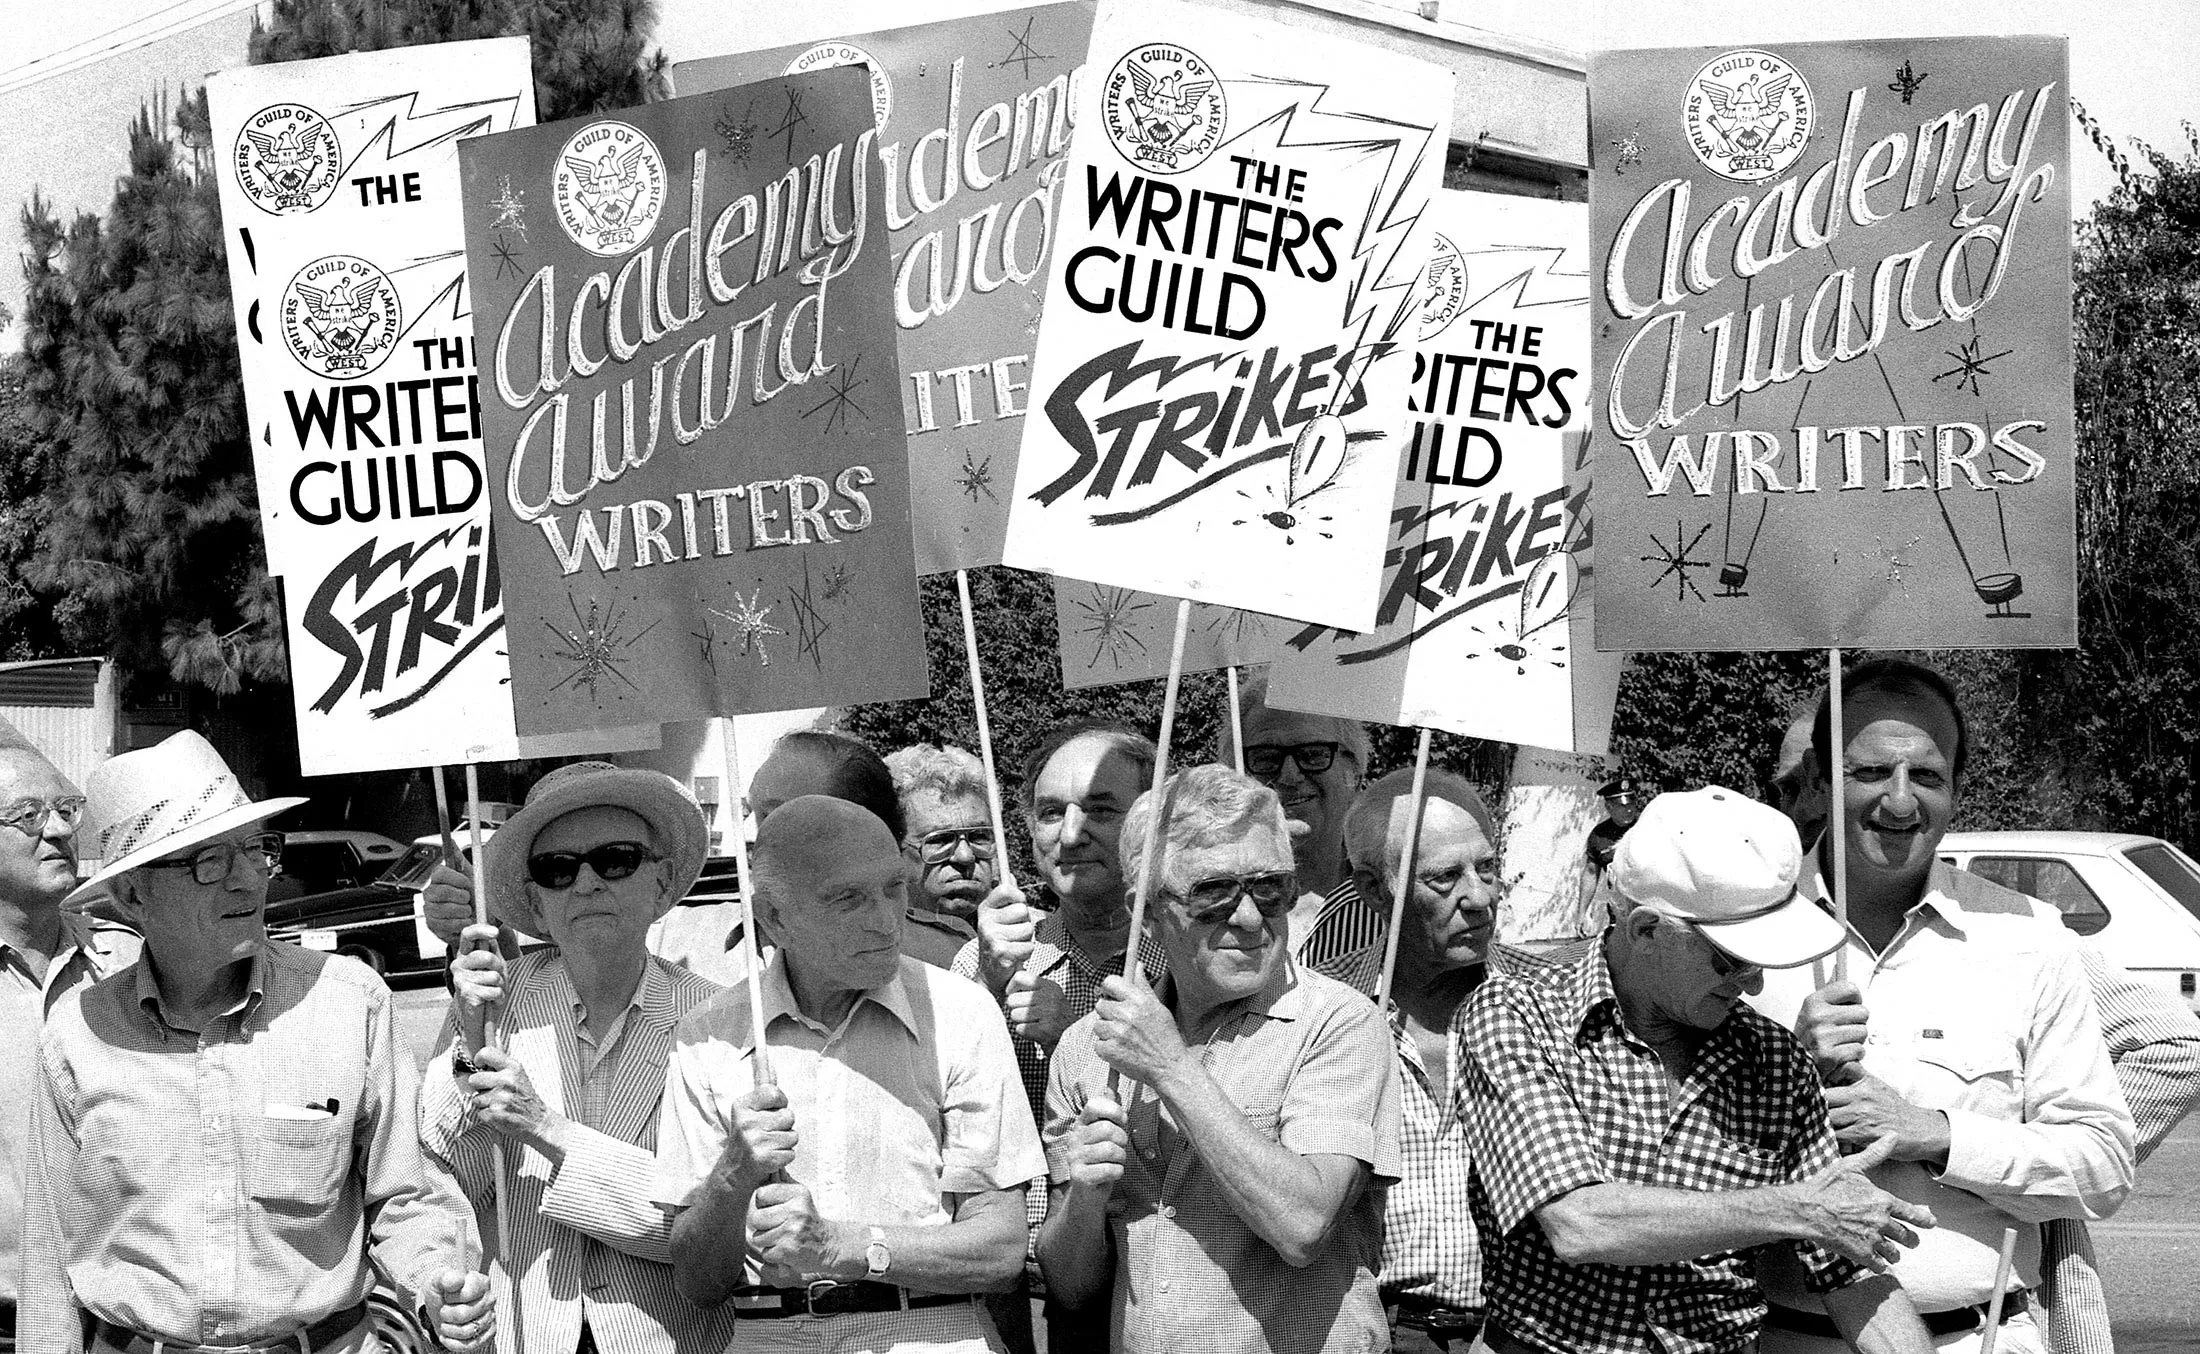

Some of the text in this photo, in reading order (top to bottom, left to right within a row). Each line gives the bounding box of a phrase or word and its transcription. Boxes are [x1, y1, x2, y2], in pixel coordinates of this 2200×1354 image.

[798, 48, 887, 127] GUILD OF AMERIC
[1107, 49, 1221, 155] WRITERS GUILD OF AMERICA
[1688, 57, 1808, 160] WRITERS GUILD OF AMERICA
[238, 108, 338, 201] WRITERS GUILD OF AMERICA
[351, 172, 422, 207] THE
[558, 173, 585, 238] WRITERS
[573, 128, 611, 153] GUILD
[614, 129, 634, 144] OF
[642, 154, 661, 220] AMERICA
[1230, 155, 1308, 203] THE
[1086, 164, 1344, 284] WRITERS
[285, 298, 312, 361] WRITERS
[306, 261, 346, 281] GUILD
[350, 262, 371, 277] OF
[378, 288, 397, 350] AMERICA
[1064, 245, 1267, 342] GUILD
[1436, 266, 1462, 323] AMERICA
[413, 335, 477, 371] TH
[1470, 319, 1544, 357] THE
[907, 354, 1028, 436] ITE
[290, 450, 483, 525] GUILD
[1622, 419, 2047, 499] WRITERS
[532, 464, 877, 577] WRITERS
